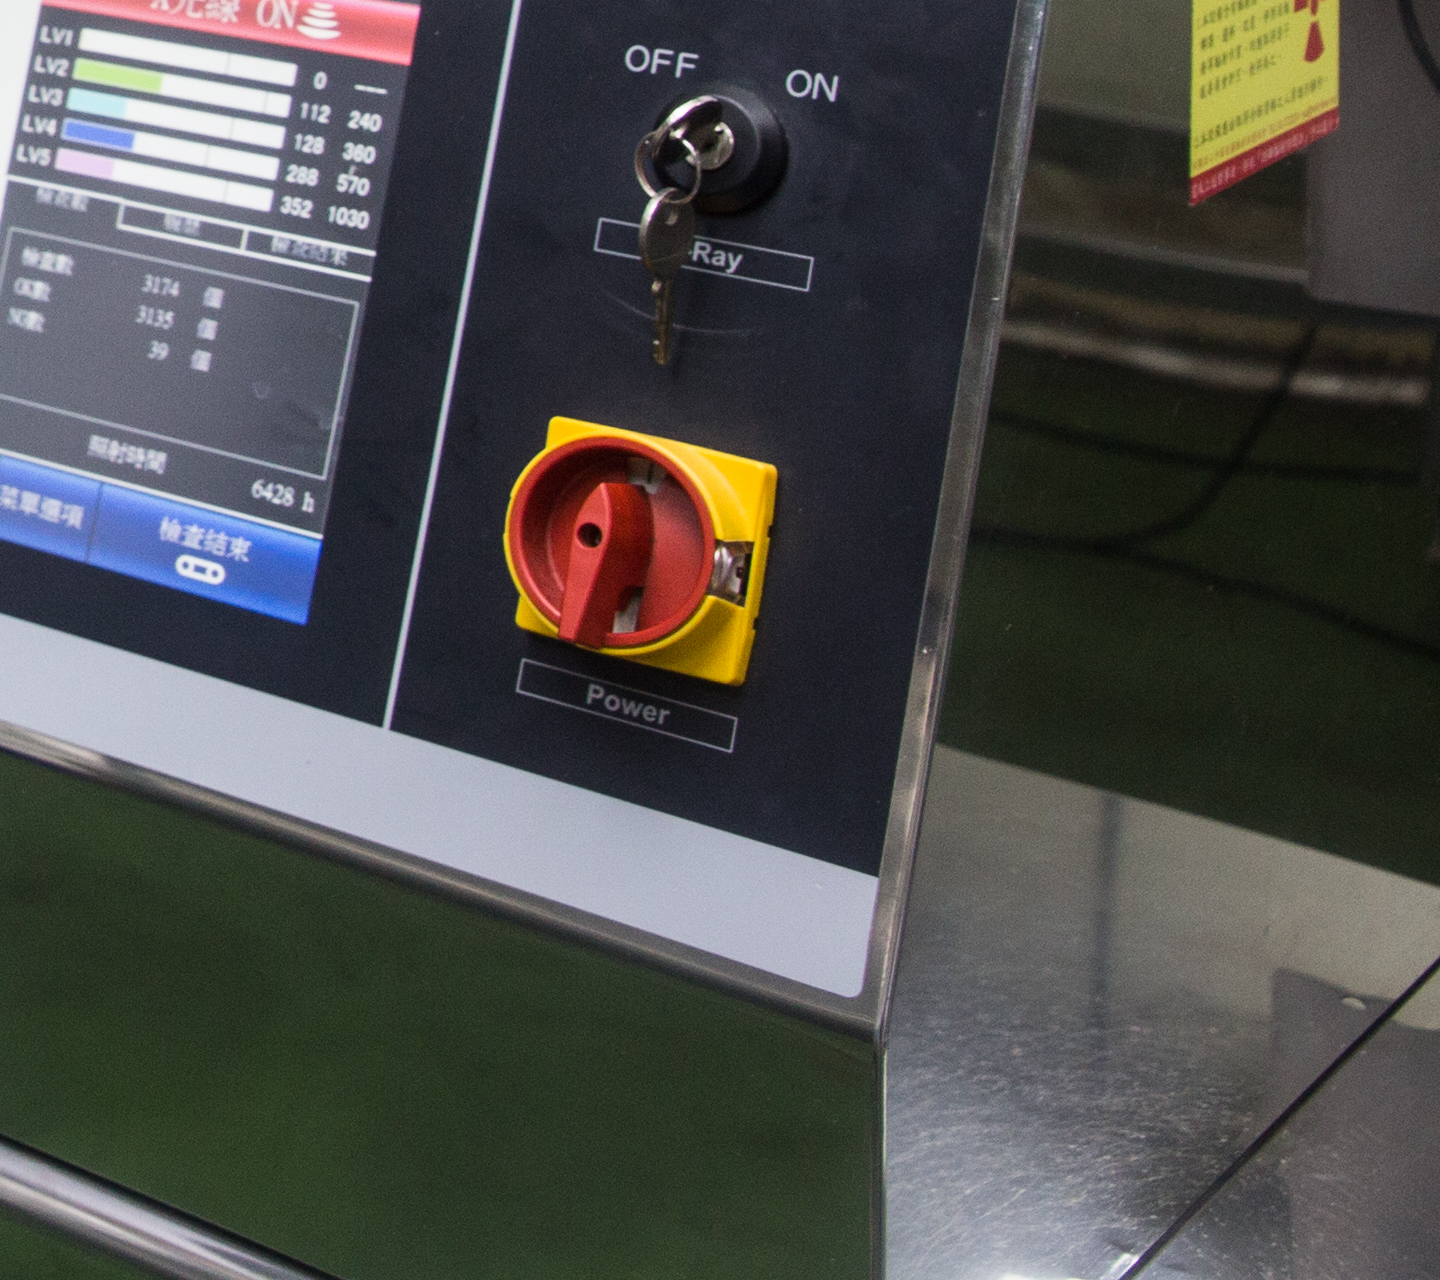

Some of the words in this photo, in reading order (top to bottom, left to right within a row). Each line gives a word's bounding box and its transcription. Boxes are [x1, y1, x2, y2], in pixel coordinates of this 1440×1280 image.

[39, 25, 73, 46] LV1
[313, 71, 328, 90] 0
[624, 45, 699, 78] OFF
[34, 55, 69, 76] LV2
[300, 102, 330, 124] 112
[347, 110, 382, 133] 240
[785, 69, 839, 102] ON
[28, 85, 64, 107] LV3
[294, 133, 325, 156] 128
[342, 142, 376, 164] 360
[22, 115, 57, 137] LV4
[285, 164, 319, 187] 288
[337, 175, 370, 197] 570
[16, 145, 52, 167] LV5
[280, 196, 313, 220] 352
[328, 206, 370, 230] 1030
[688, 241, 743, 274] -Ray
[147, 340, 169, 361] 39
[251, 479, 294, 509] 6428
[303, 490, 316, 514] h
[586, 683, 670, 724] Power
